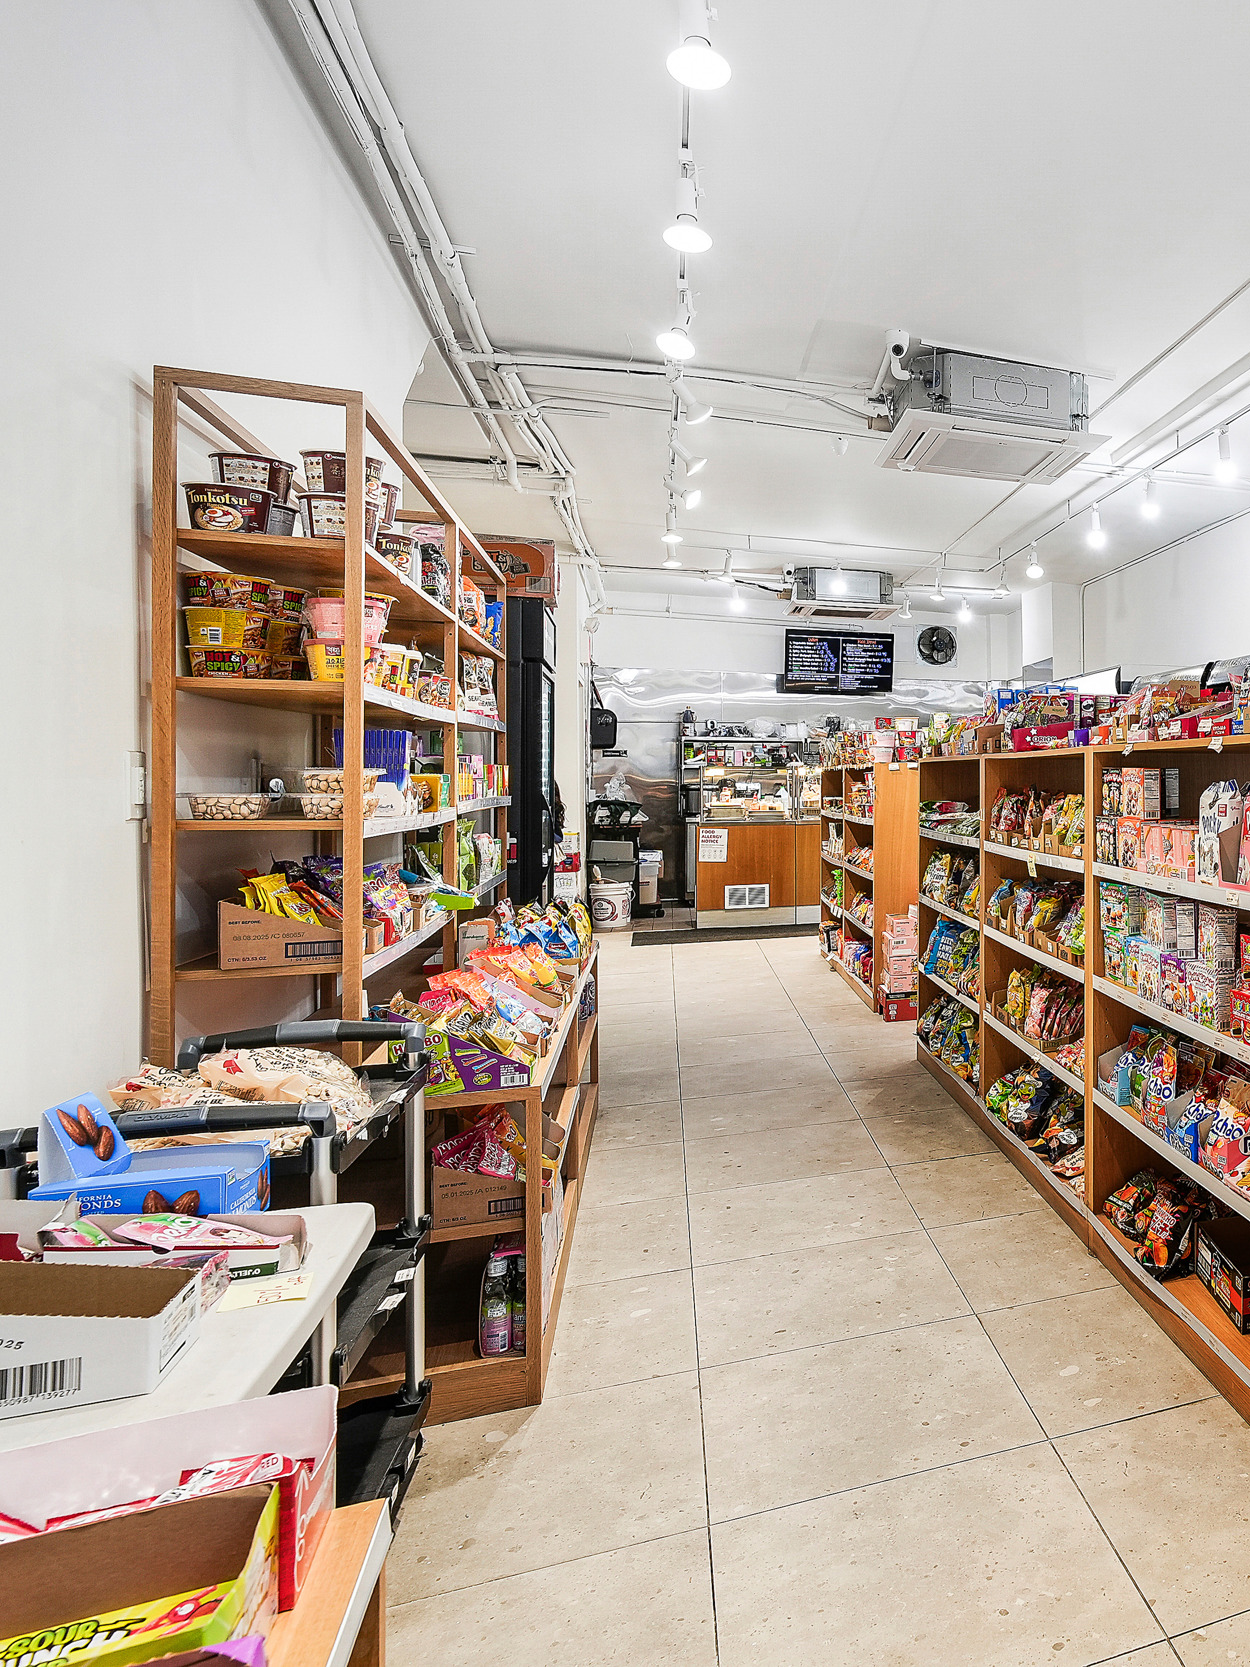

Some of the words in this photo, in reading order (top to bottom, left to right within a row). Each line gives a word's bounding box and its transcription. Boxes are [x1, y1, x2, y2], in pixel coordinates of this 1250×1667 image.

[188, 490, 249, 506] Tonkotsu
[206, 651, 231, 663] HOT
[231, 655, 241, 663] &
[206, 661, 241, 673] SPICY
[8, 1619, 99, 1658] SOUR
